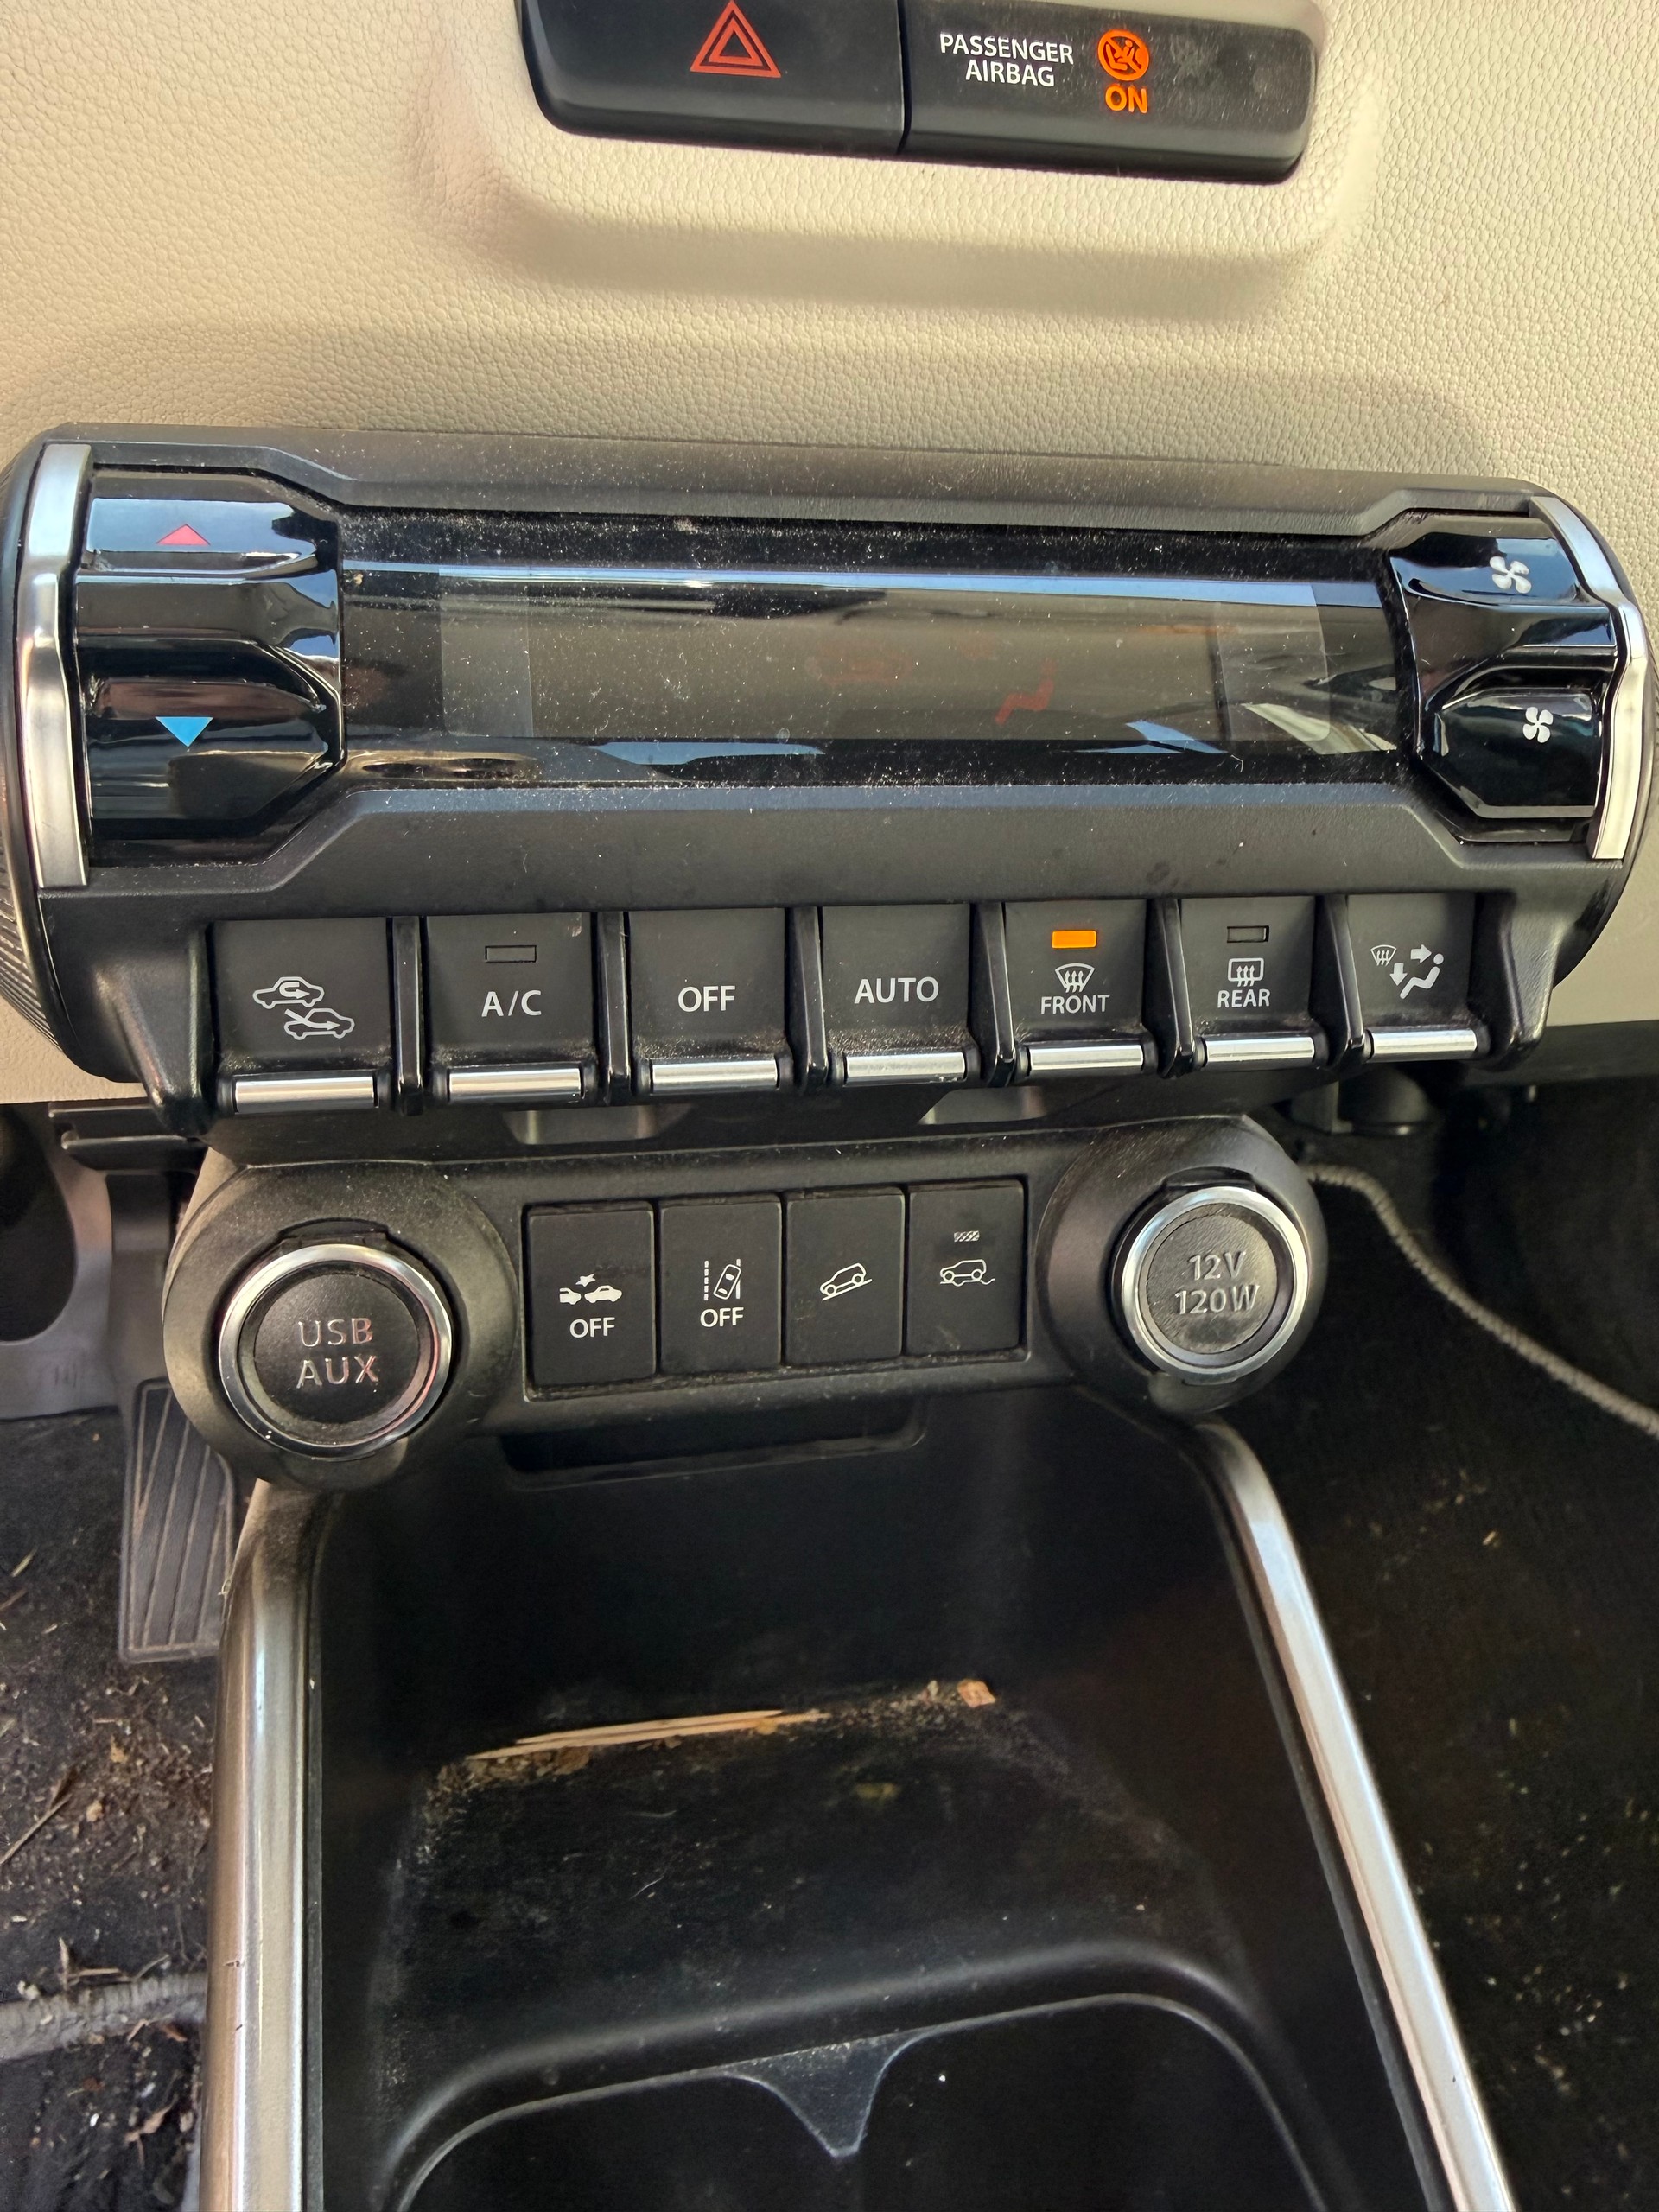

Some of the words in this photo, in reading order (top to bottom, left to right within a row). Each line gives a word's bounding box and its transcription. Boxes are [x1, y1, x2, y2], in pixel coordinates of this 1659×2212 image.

[939, 32, 1074, 65] PASSENGER
[965, 59, 1055, 87] AIRBAG
[1105, 82, 1148, 114] ON
[480, 989, 542, 1018] A/C
[677, 985, 736, 1013] OFF
[854, 976, 940, 1004] AUTO
[1217, 989, 1271, 1009] REAR
[1039, 995, 1110, 1015] FRONT
[1187, 1250, 1247, 1281] 12V
[1174, 1284, 1260, 1315] 120W
[569, 1317, 616, 1338] OFF
[700, 1306, 744, 1328] OFF
[297, 1317, 374, 1348] USB
[296, 1355, 379, 1389] AUX
